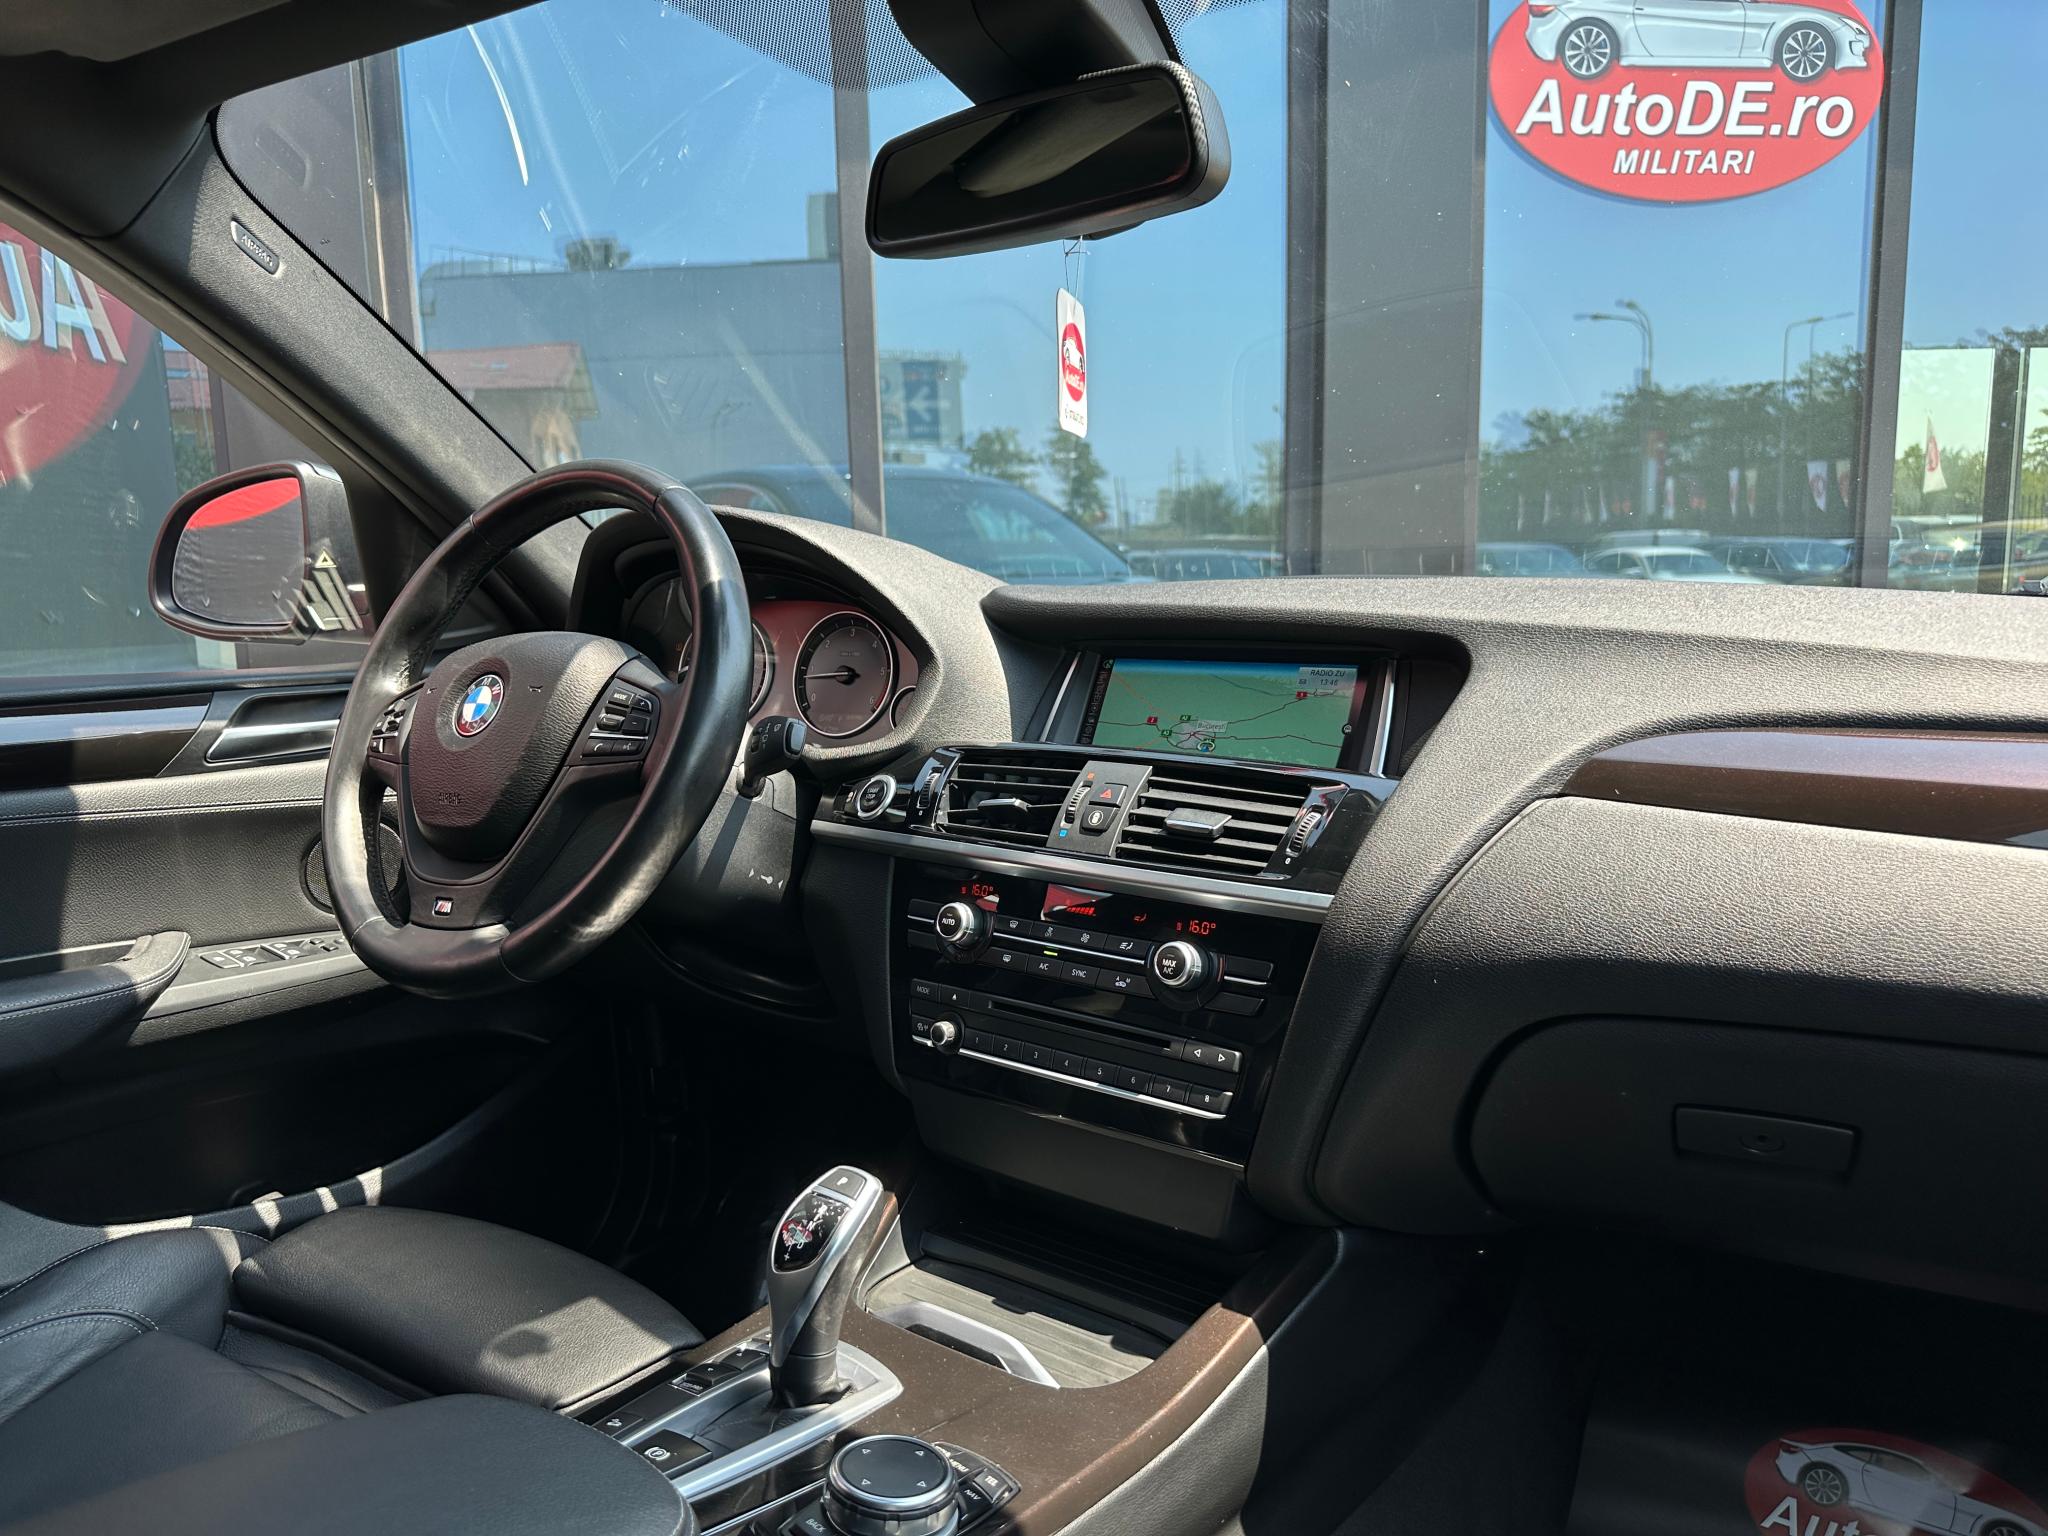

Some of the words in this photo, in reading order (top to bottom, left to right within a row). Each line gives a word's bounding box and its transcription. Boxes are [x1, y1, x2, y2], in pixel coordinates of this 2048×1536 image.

[1515, 78, 1855, 138] AutoDE.ro
[1612, 149, 1755, 175] MILITARI
[467, 677, 502, 696] BMW
[941, 917, 956, 926] AUTO
[1038, 962, 1050, 970] A/C
[1162, 958, 1177, 968] MAX
[1071, 968, 1088, 978] SYNC
[1162, 967, 1174, 975] A/C
[916, 985, 931, 995] MODE
[984, 1475, 999, 1487] TEL
[964, 1489, 981, 1500] NAV
[805, 1517, 827, 1533] BACK
